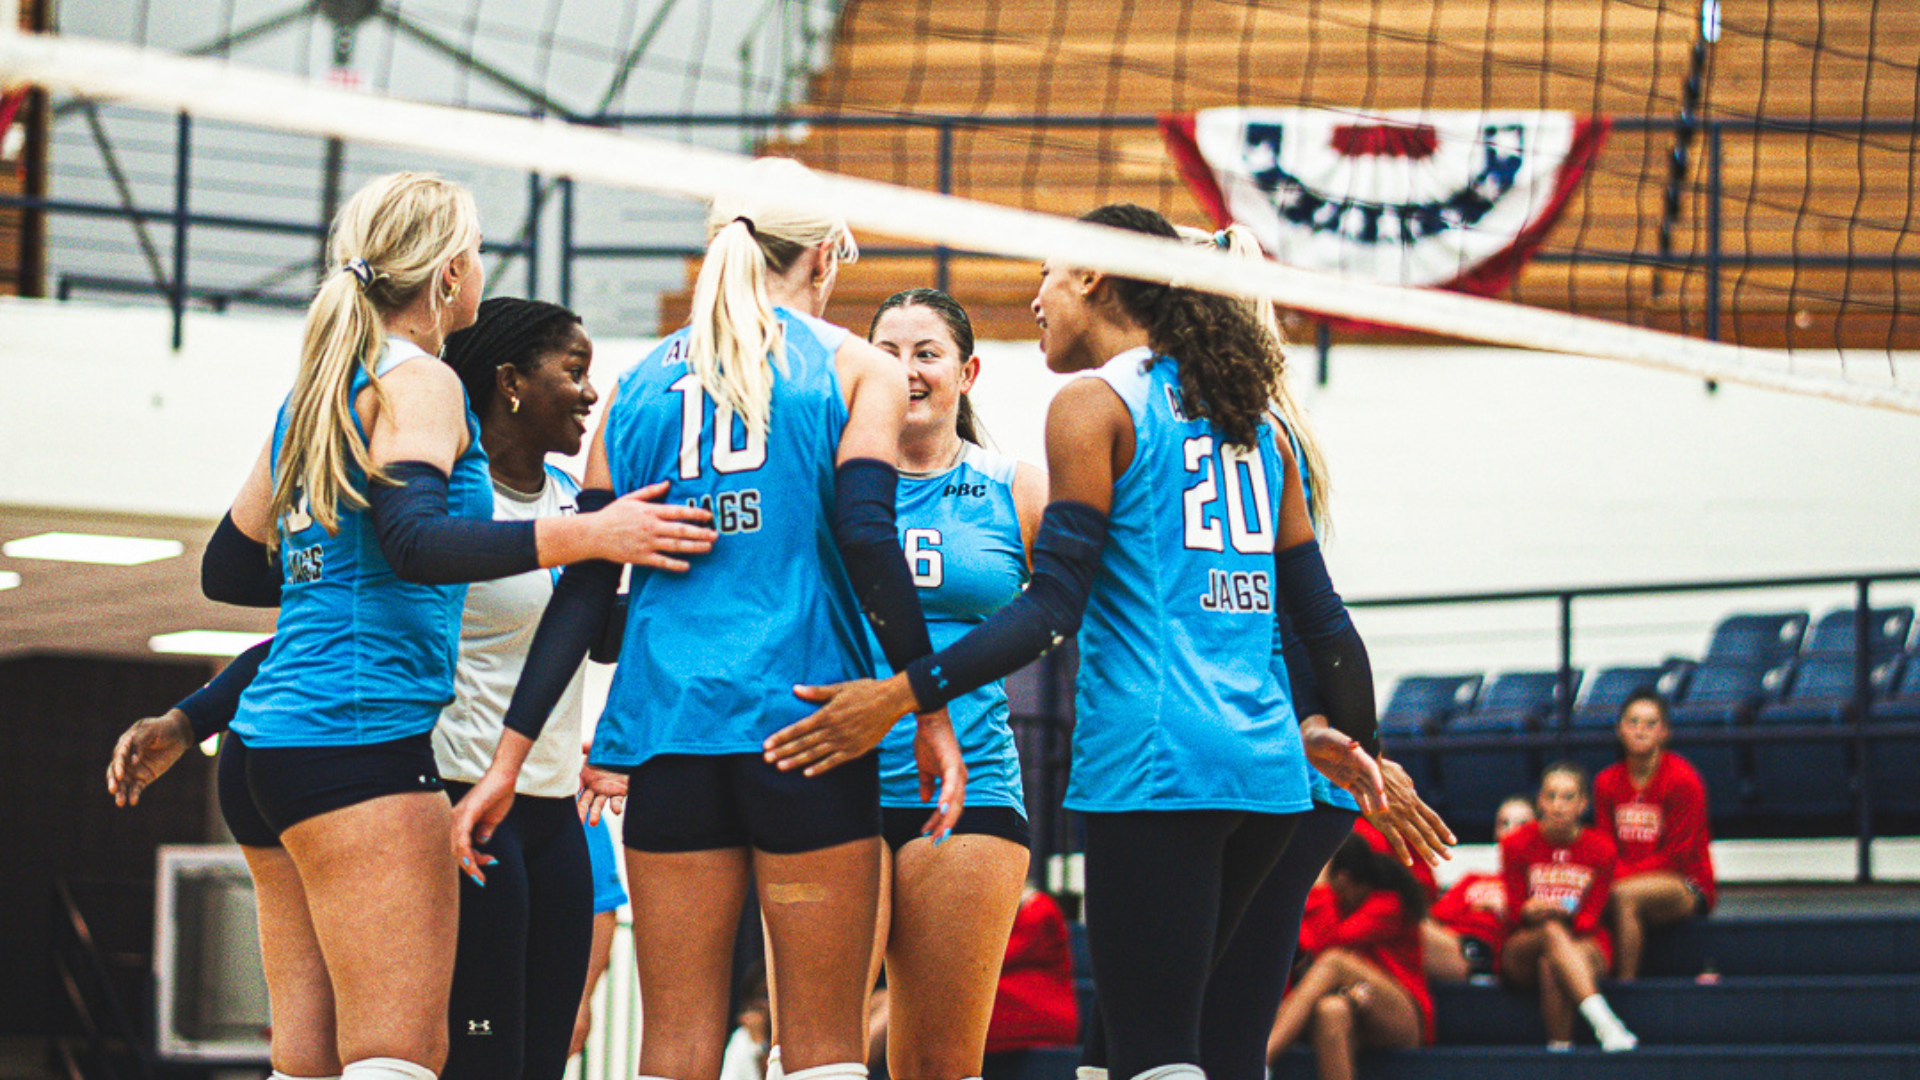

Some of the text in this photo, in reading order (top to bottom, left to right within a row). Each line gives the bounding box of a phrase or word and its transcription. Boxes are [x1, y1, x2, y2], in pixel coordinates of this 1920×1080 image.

[1182, 434, 1274, 554] 20
[905, 527, 944, 588] 6
[1201, 568, 1273, 613] JAGS
